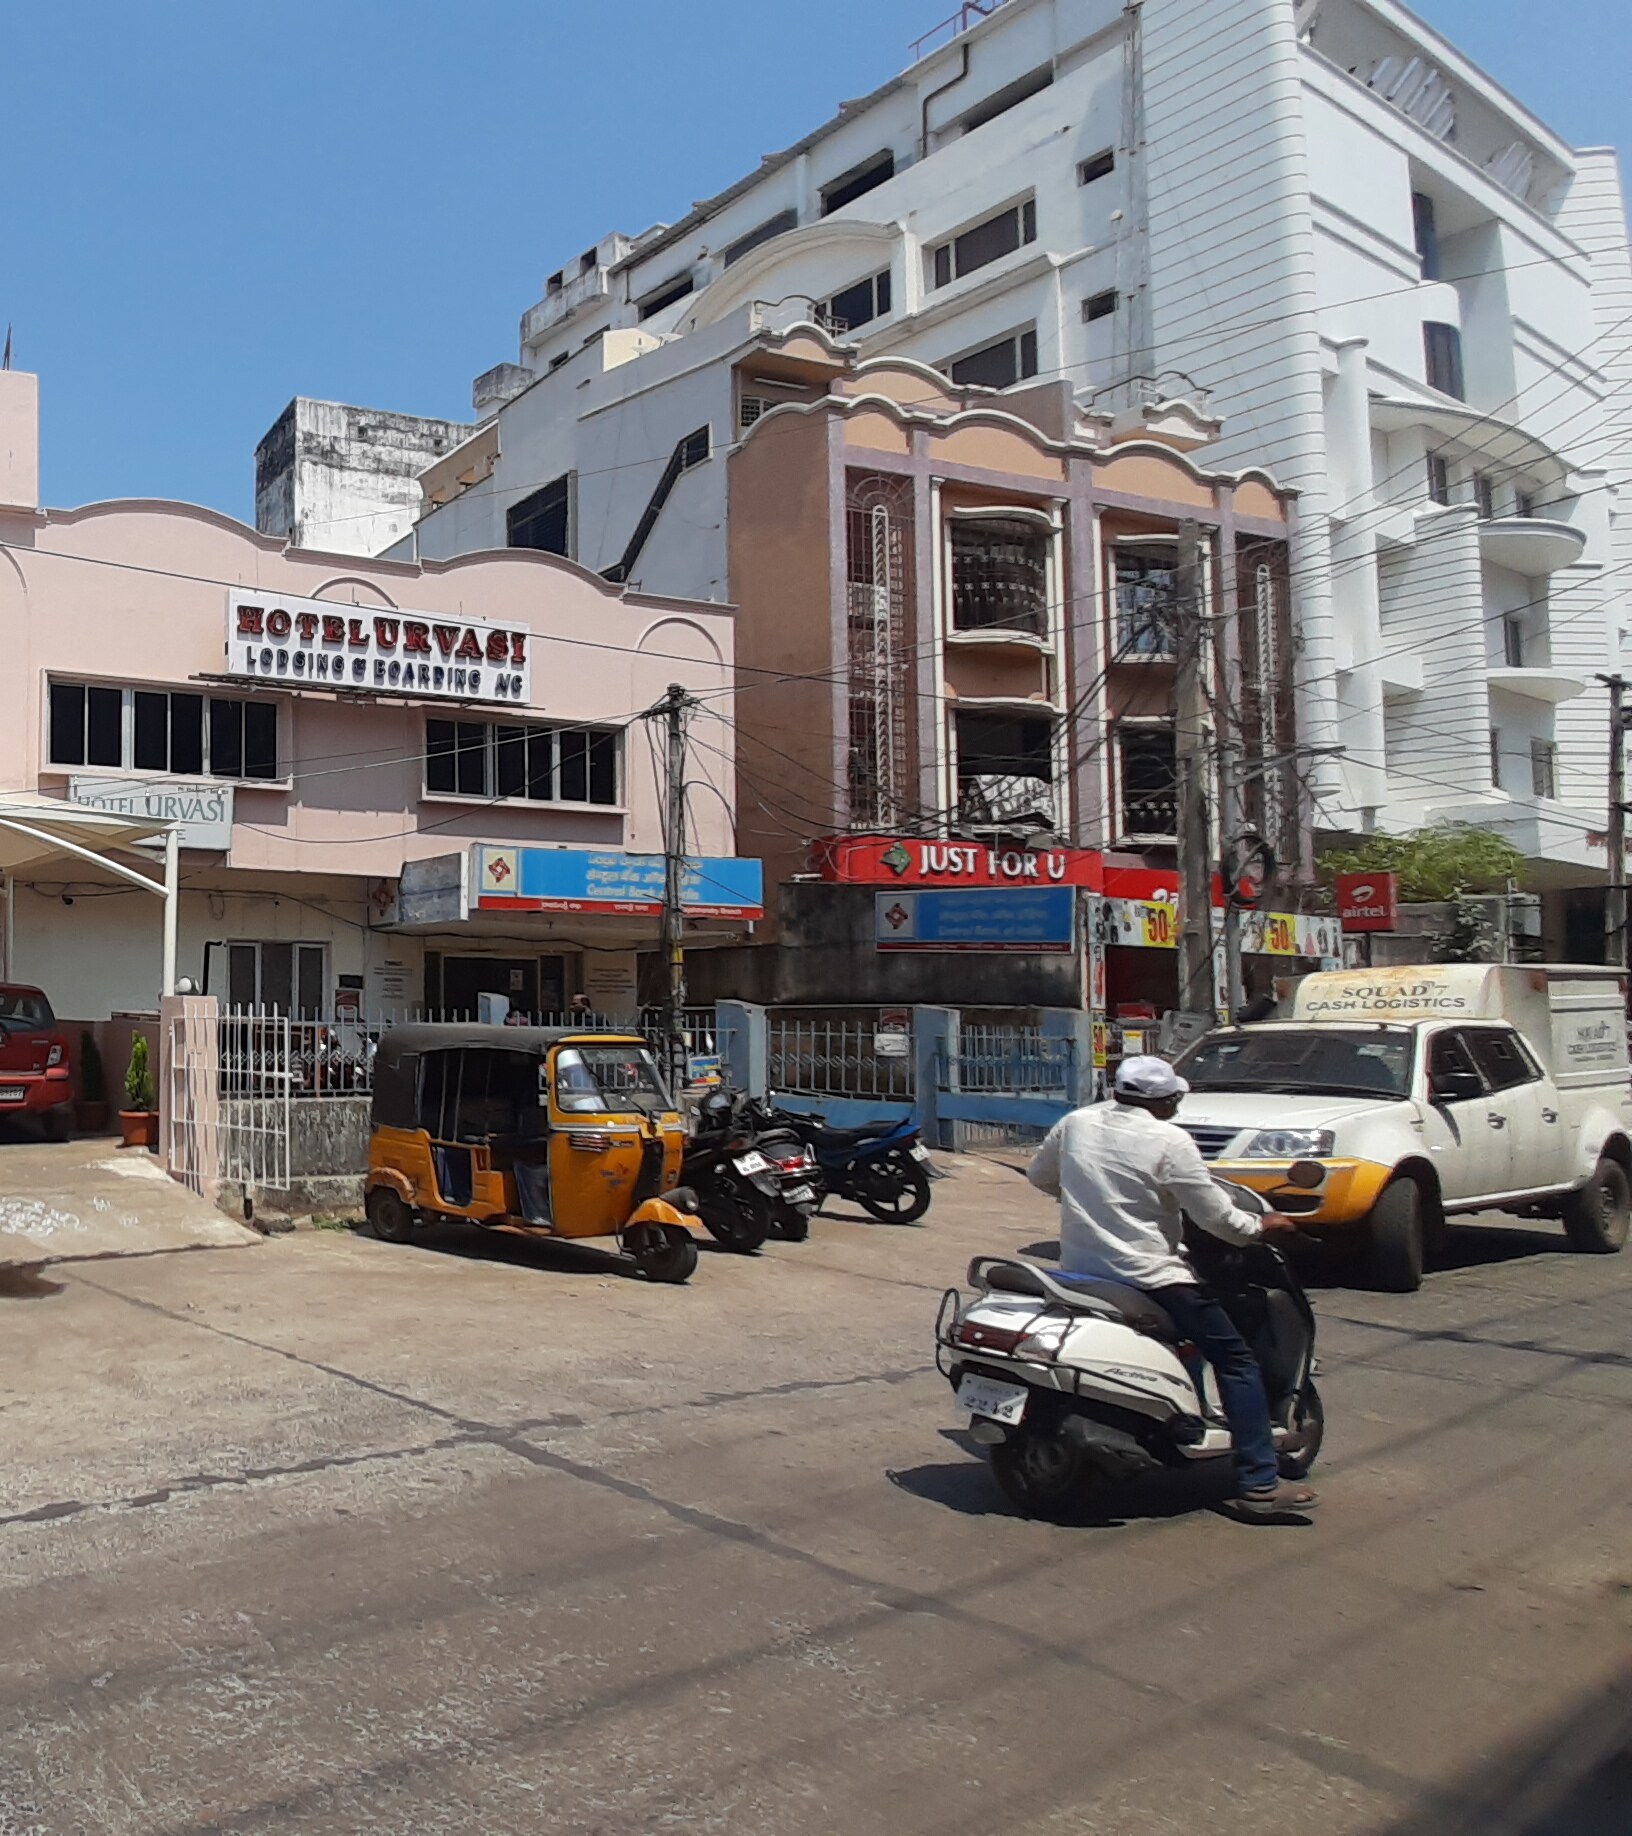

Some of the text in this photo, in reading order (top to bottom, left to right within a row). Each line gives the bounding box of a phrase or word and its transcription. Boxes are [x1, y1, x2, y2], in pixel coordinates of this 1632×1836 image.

[237, 605, 526, 663] HOTEL URVASI
[246, 645, 345, 673] LODGING
[373, 658, 482, 688] BOARDING
[147, 796, 225, 822] URVASI
[919, 845, 1066, 879] JUST FOR U
[1343, 905, 1386, 918] airtel
[1306, 997, 1466, 1012] CASH LOGISTICS
[1342, 985, 1428, 999] SQUAD
